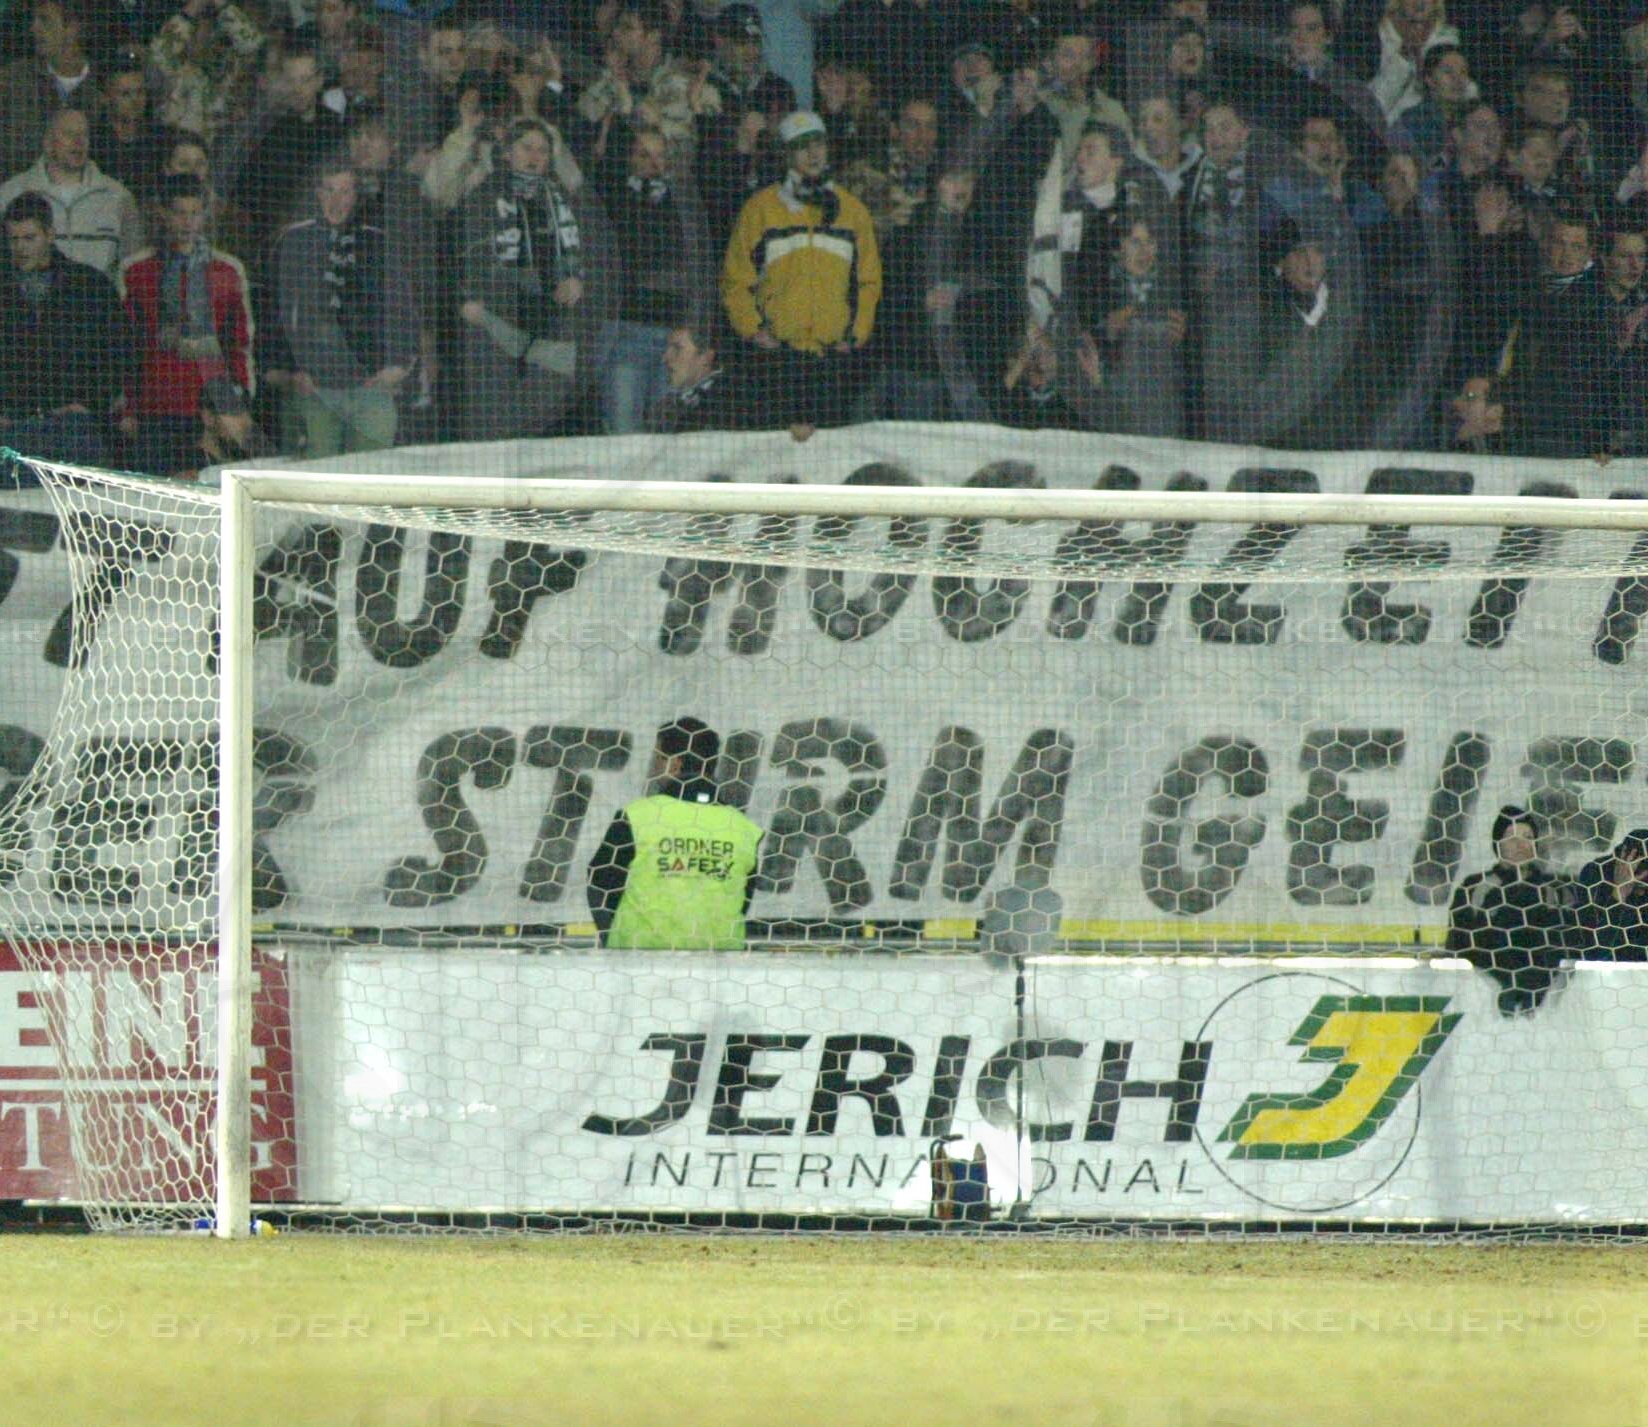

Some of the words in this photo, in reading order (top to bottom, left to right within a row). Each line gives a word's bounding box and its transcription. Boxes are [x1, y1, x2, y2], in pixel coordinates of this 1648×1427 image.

[207, 505, 593, 686] AUF
[658, 837, 734, 859] ORDNER
[582, 1032, 1214, 1143] JERICH
[623, 1152, 1205, 1195] INTERNONAL
